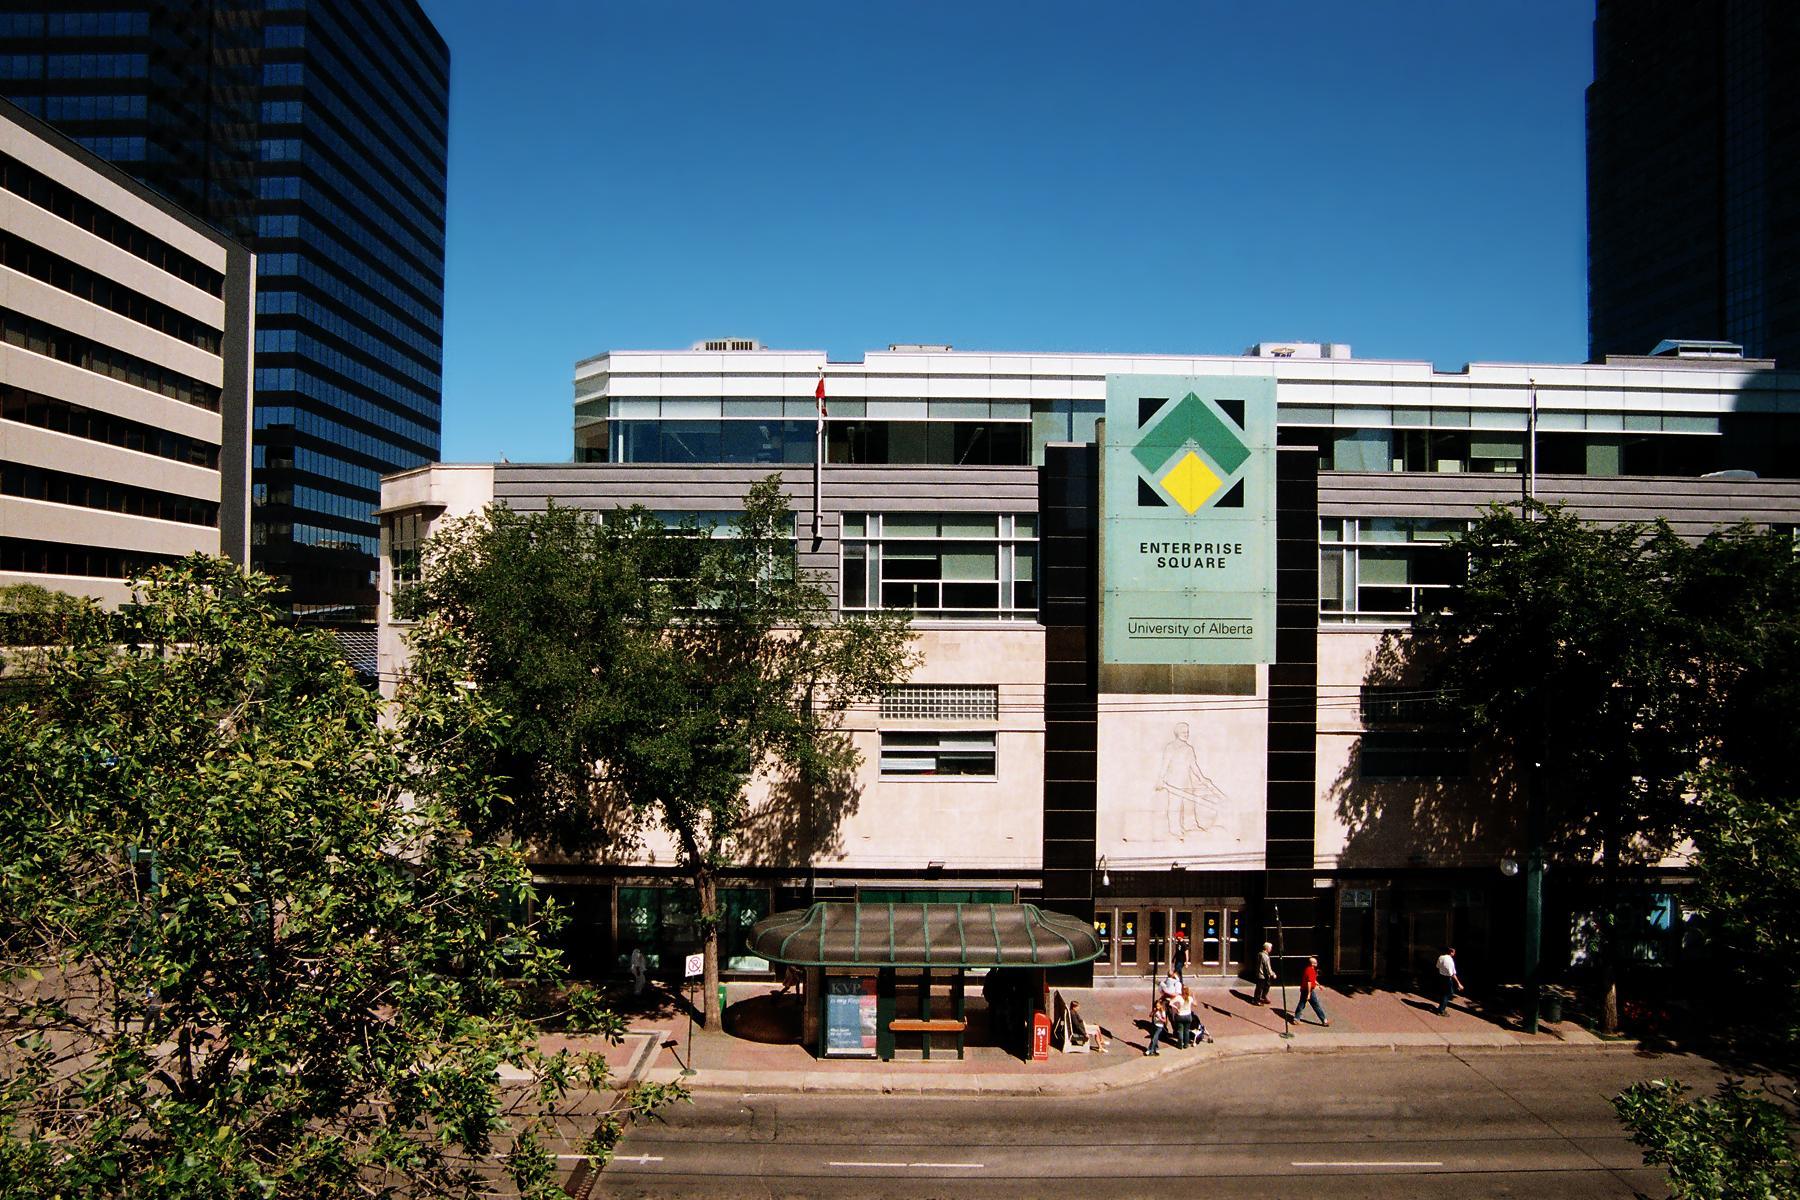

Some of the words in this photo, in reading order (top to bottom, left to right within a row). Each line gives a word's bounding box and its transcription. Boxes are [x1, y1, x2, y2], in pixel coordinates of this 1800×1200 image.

[1140, 542, 1242, 554] ENTERPRISE
[1157, 557, 1226, 568] SQUARE
[1128, 622, 1189, 636] University
[1193, 623, 1206, 634] of
[1209, 623, 1253, 634] Alberta
[831, 983, 861, 994] KVP
[1036, 1027, 1046, 1036] 24
